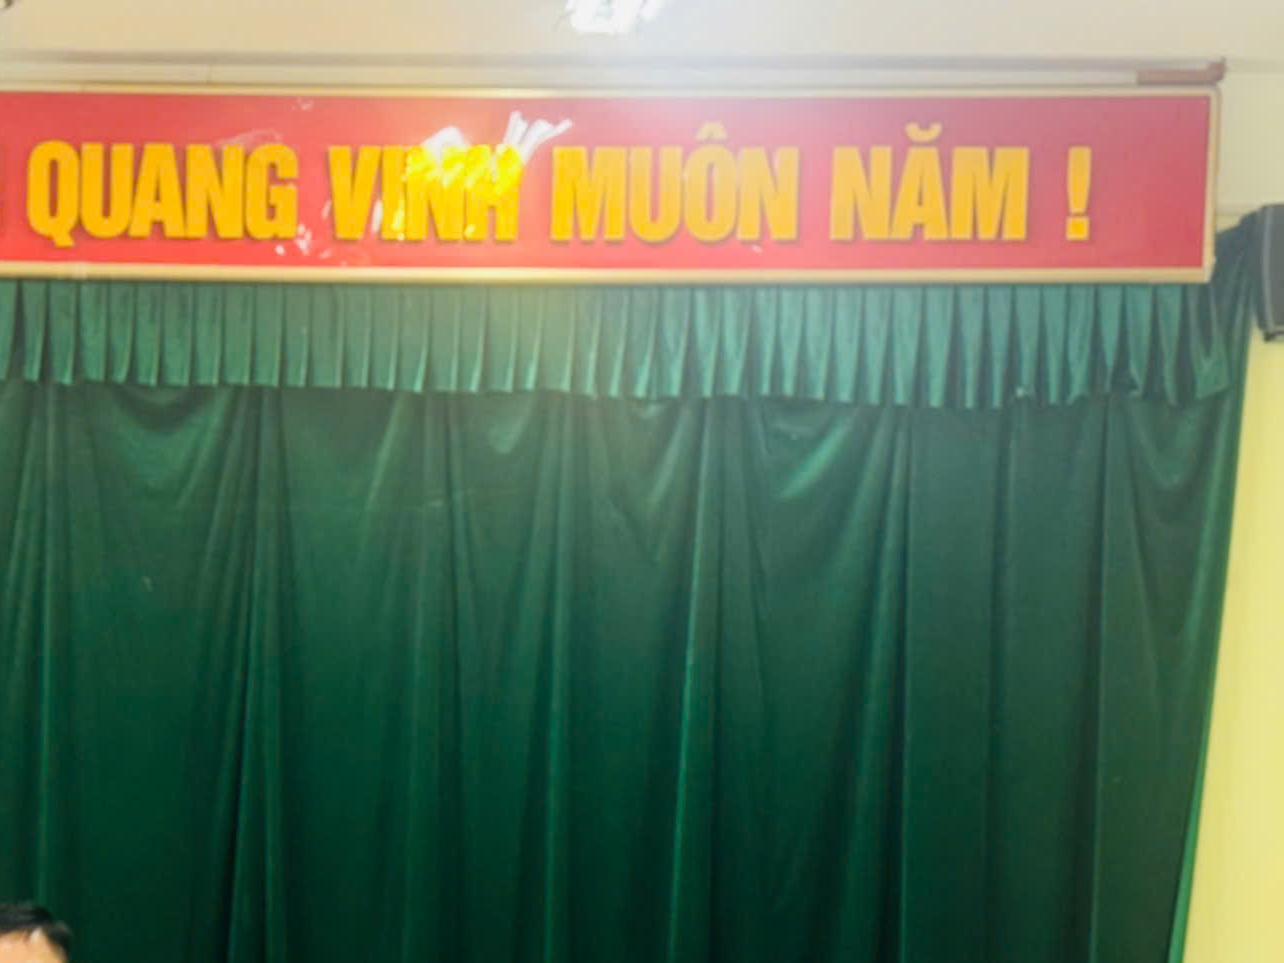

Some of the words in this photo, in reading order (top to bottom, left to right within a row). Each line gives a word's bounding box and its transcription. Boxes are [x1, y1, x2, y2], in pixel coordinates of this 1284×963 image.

[27, 141, 299, 247] QUANG
[329, 144, 520, 241] VINH
[551, 122, 799, 243] MUÔN
[830, 123, 1030, 242] NĂM
[1066, 146, 1091, 242] !
